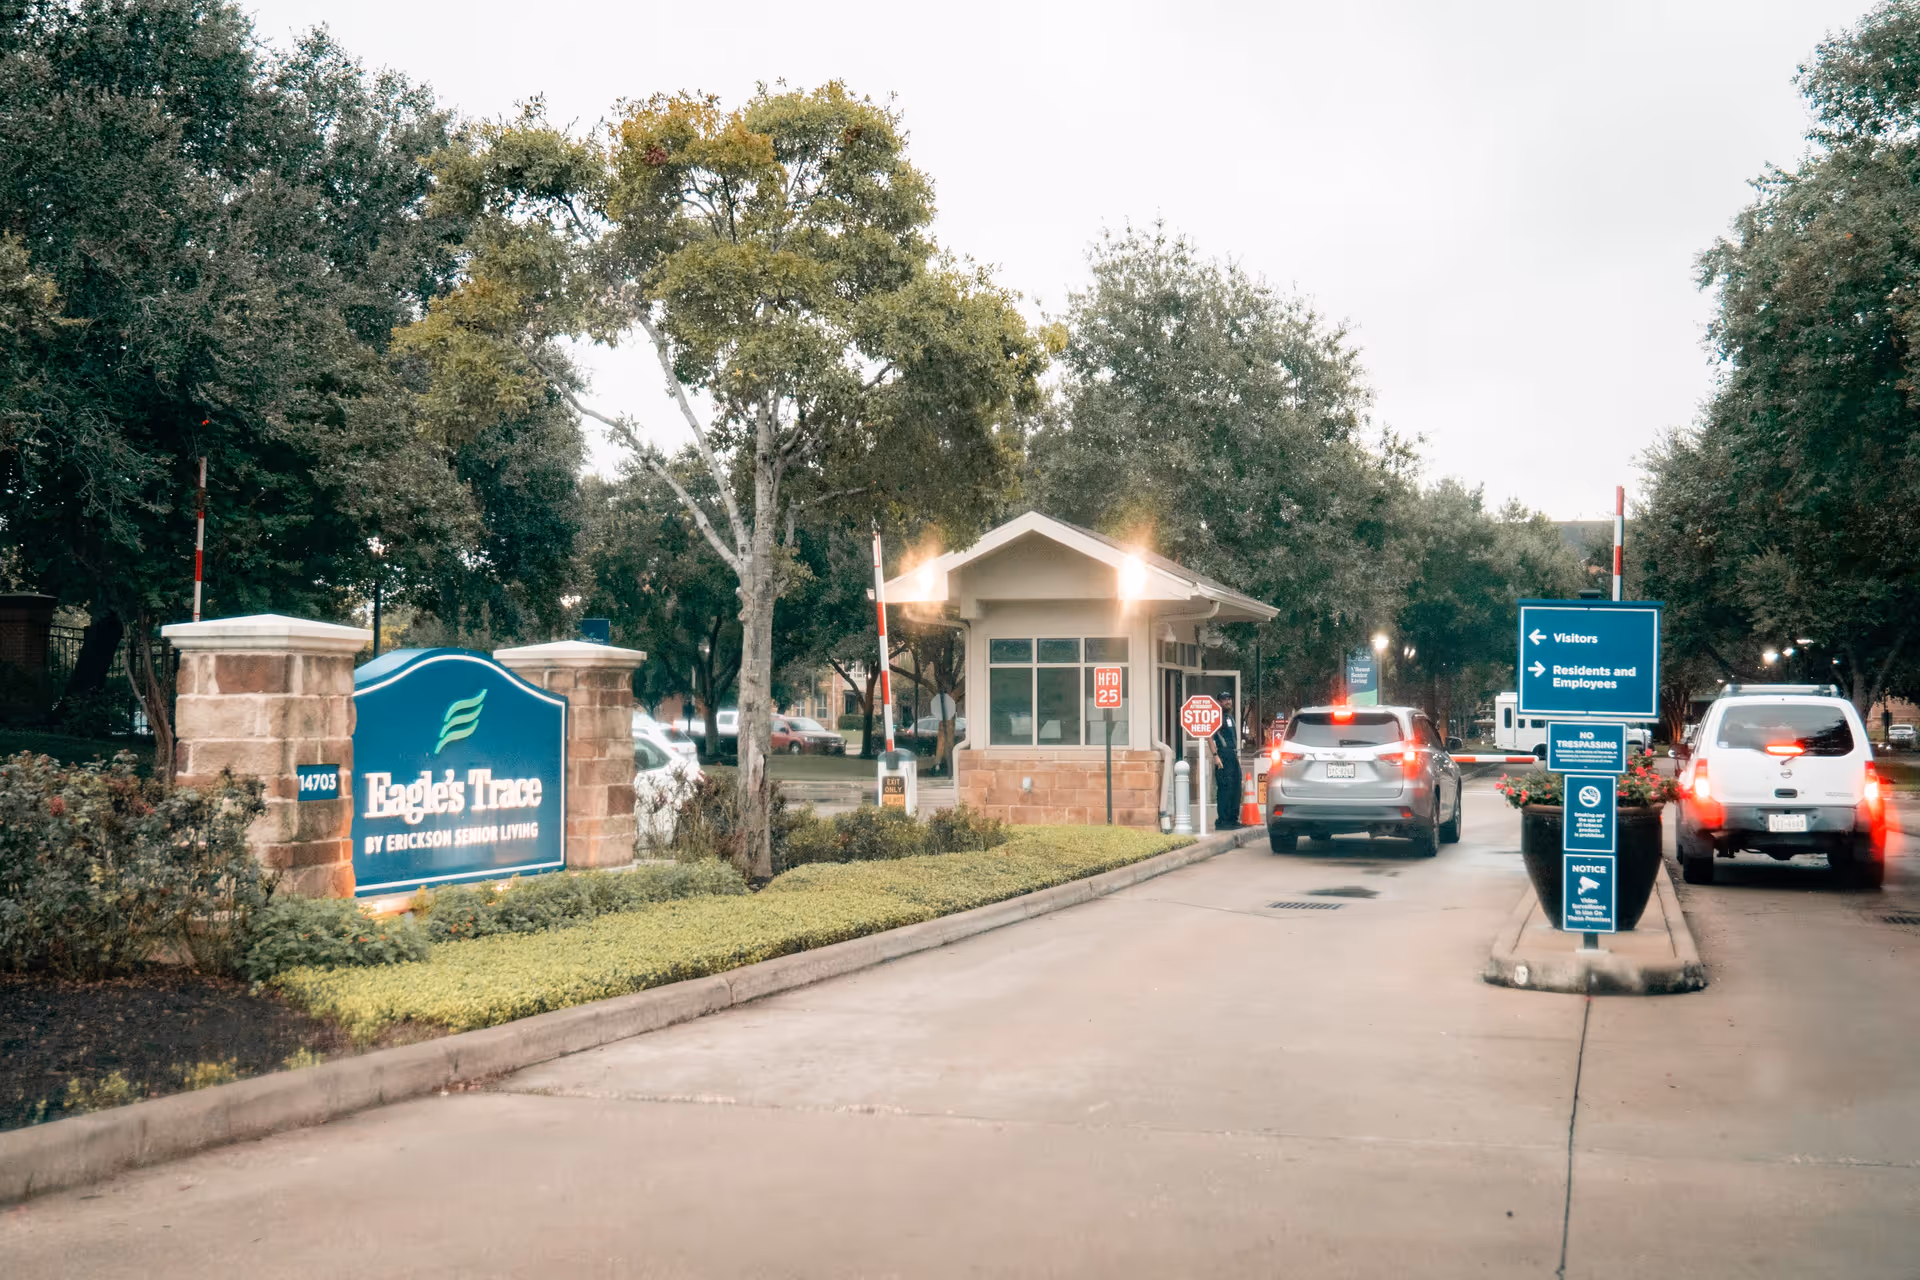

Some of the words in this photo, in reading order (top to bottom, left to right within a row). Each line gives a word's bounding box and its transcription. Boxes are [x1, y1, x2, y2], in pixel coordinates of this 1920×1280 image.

[1553, 633, 1598, 644] Visitors
[1553, 665, 1611, 676] Residents
[1613, 667, 1636, 677] and
[1098, 672, 1119, 686] HFD
[1553, 677, 1617, 690] Employees
[1098, 689, 1118, 703] 25
[1184, 710, 1220, 723] STOP
[1191, 724, 1212, 732] HERE
[1579, 731, 1595, 740] NO
[1556, 740, 1617, 749] TRESPASSING
[299, 773, 337, 792] 14703
[887, 778, 900, 786] EXIT
[363, 769, 465, 825] Eagle's
[468, 768, 543, 811] Trace
[365, 836, 384, 854] BY
[386, 829, 452, 852] ERICKSON
[454, 825, 498, 846] SENIOR
[500, 822, 539, 841] LIVING
[1572, 865, 1607, 873] NOTICE
